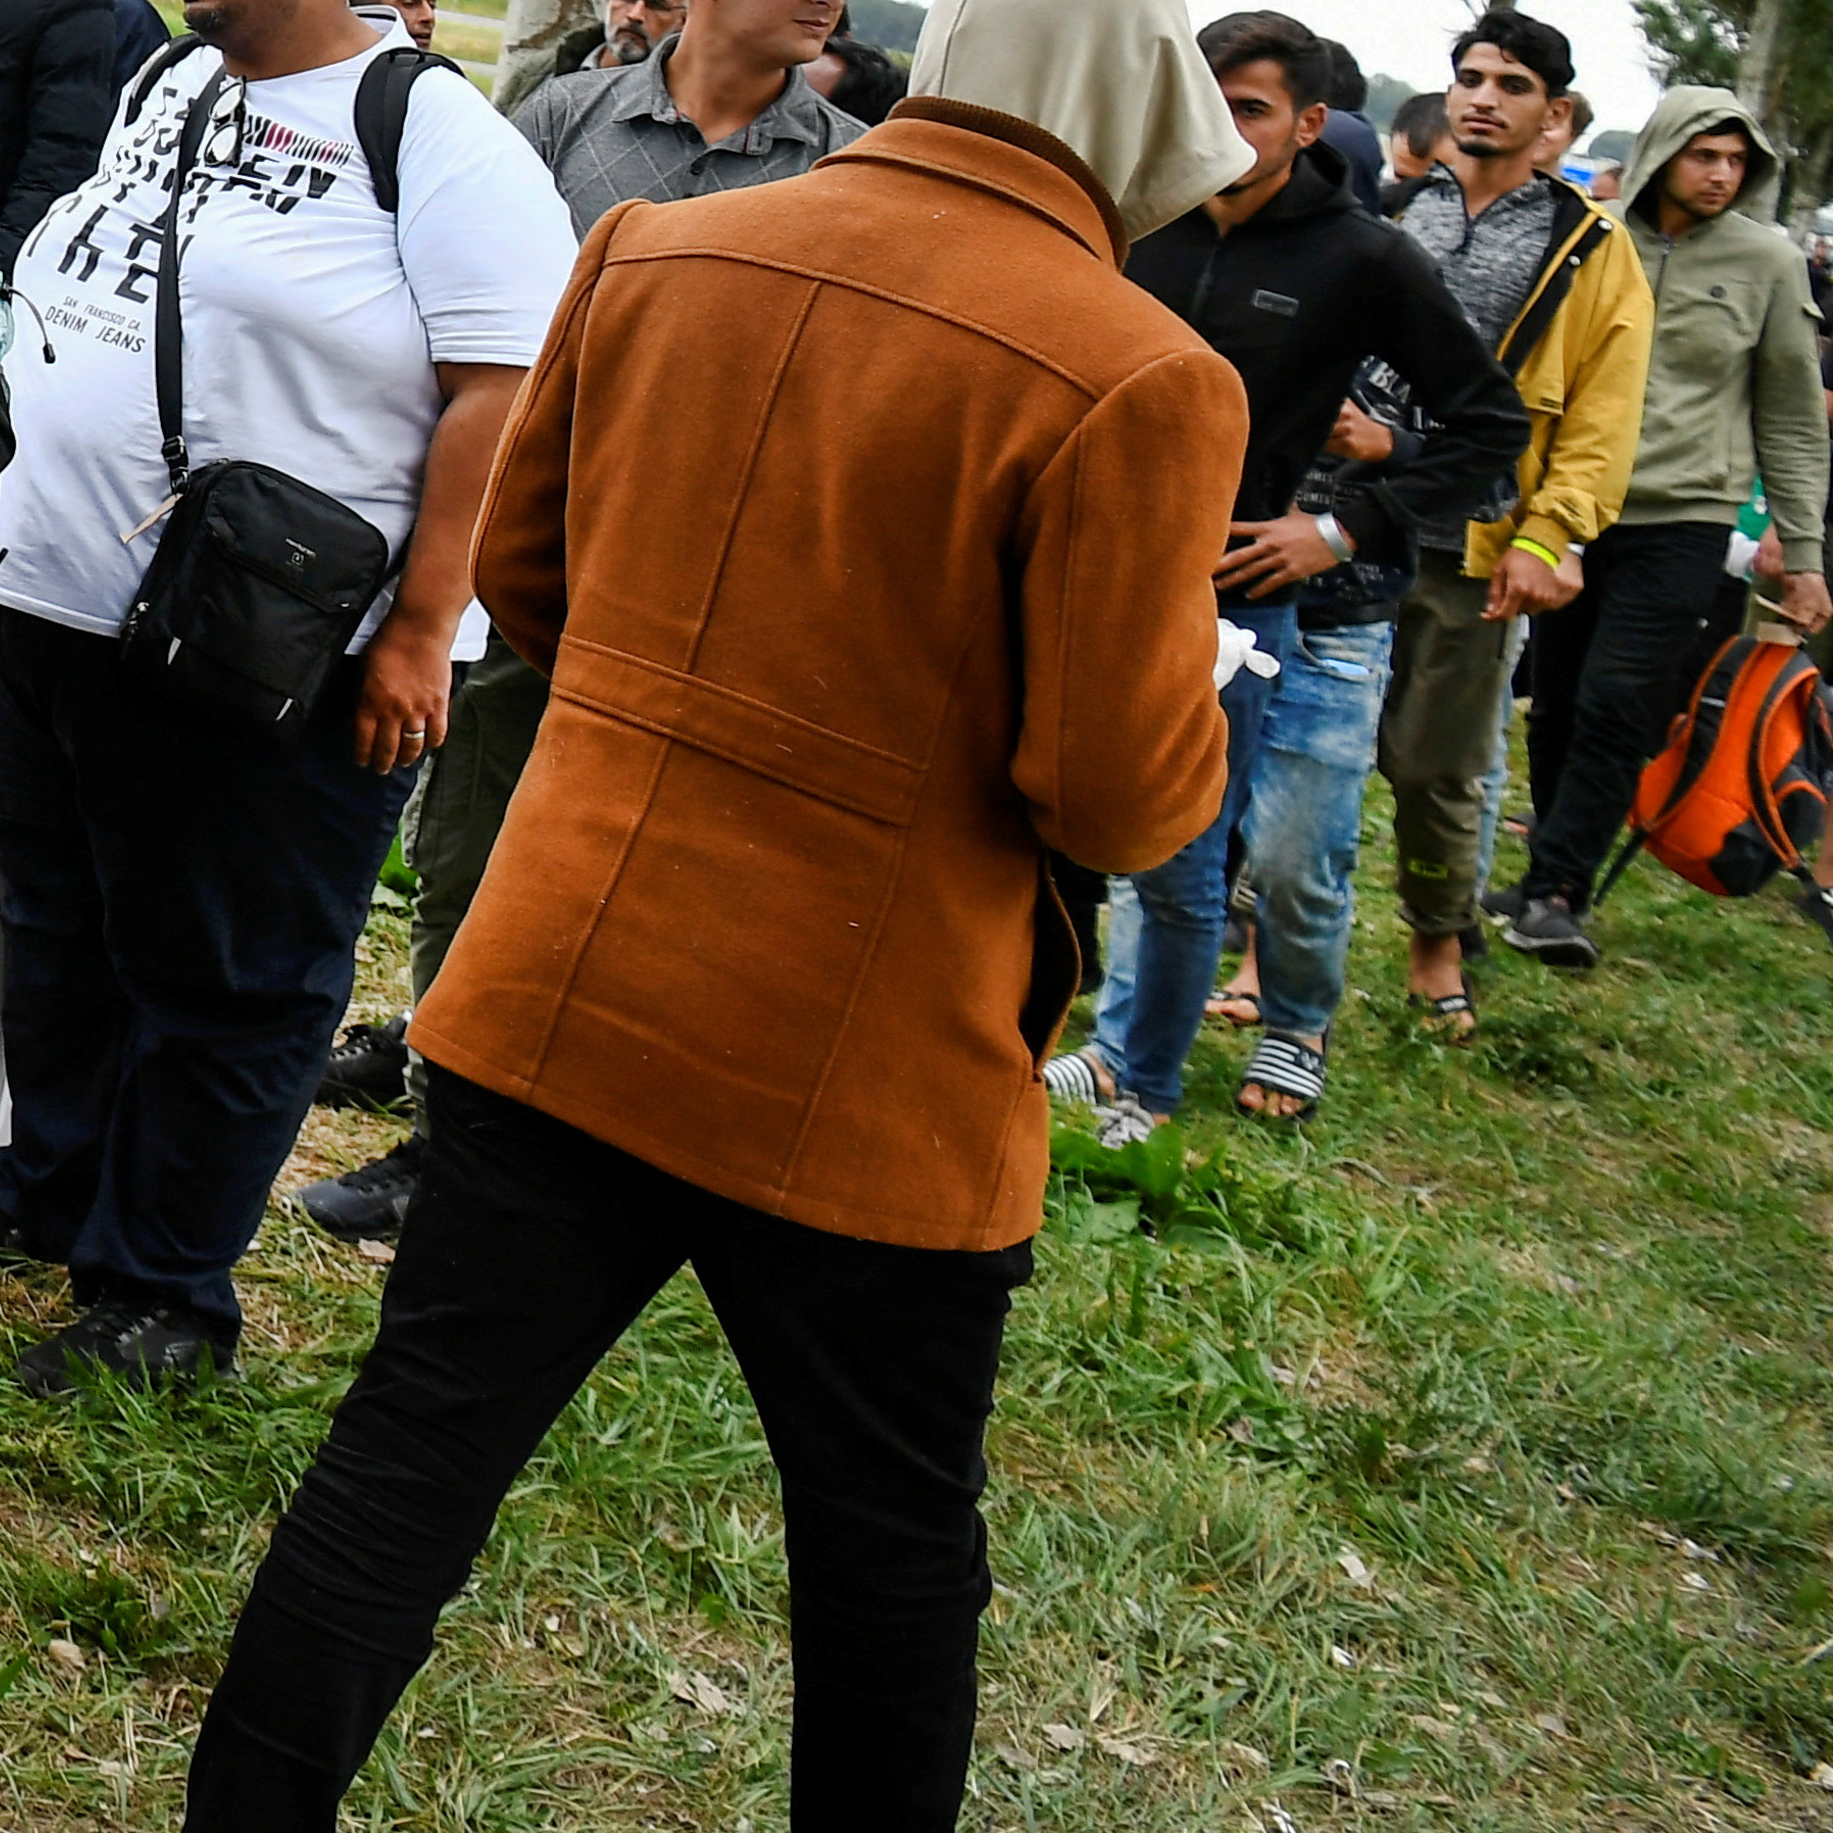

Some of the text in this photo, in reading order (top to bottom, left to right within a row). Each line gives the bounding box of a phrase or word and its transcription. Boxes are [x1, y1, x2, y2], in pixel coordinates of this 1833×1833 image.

[44, 305, 147, 353] DENIM JEANS
[83, 304, 127, 326] FRANCISCO
